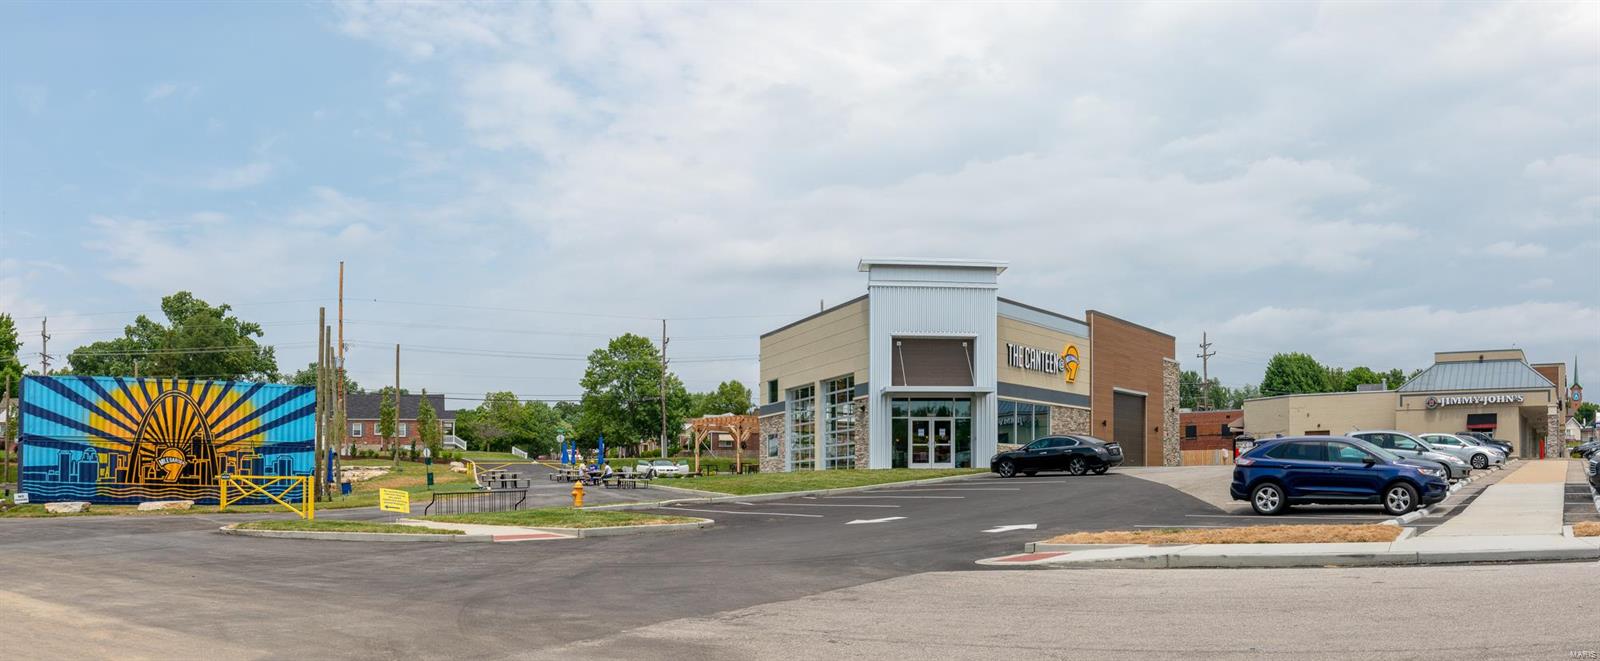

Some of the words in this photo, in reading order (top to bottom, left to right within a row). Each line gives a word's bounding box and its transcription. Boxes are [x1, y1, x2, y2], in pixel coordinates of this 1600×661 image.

[1007, 343, 1023, 368] THE
[1024, 347, 1058, 375] CANTEEN
[1440, 395, 1480, 407] JIMMY
[1482, 394, 1524, 406] JOHN'S
